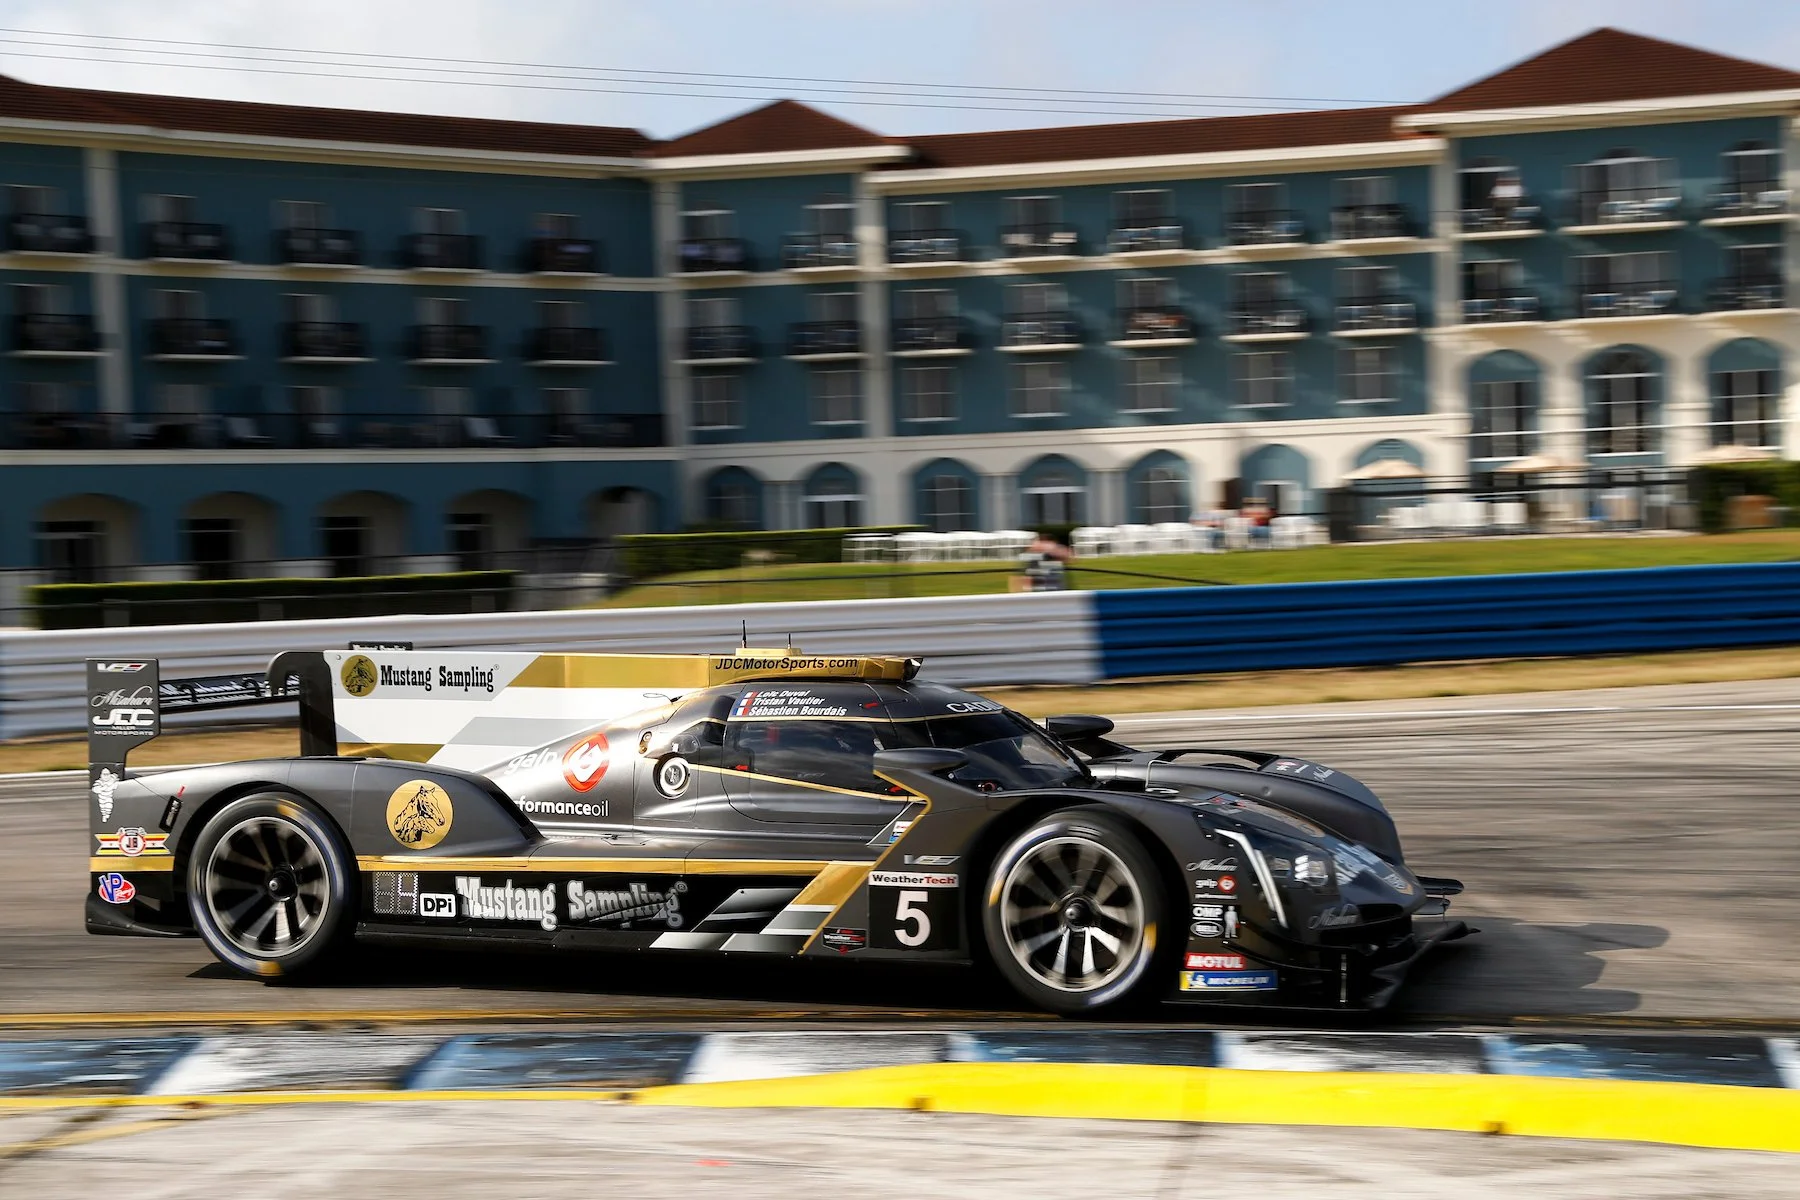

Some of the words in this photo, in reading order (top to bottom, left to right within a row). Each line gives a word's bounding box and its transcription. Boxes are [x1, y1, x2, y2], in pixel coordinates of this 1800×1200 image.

[715, 657, 858, 671] JDCMotorSports.com
[380, 665, 432, 692] Mustang
[439, 665, 494, 693] Sampling
[752, 697, 787, 706] Tristan
[788, 697, 826, 705] Vautier
[779, 690, 811, 698] Duval
[92, 708, 155, 726] JDC
[748, 706, 799, 716] Sébastien
[800, 705, 848, 716] Bourdais
[503, 747, 558, 776] galp
[98, 872, 124, 902] VP
[872, 874, 957, 885] WeatherTech
[423, 896, 453, 913] DPi
[455, 876, 558, 931] Mustang
[894, 890, 932, 947] 5
[1186, 955, 1244, 969] MOTUL
